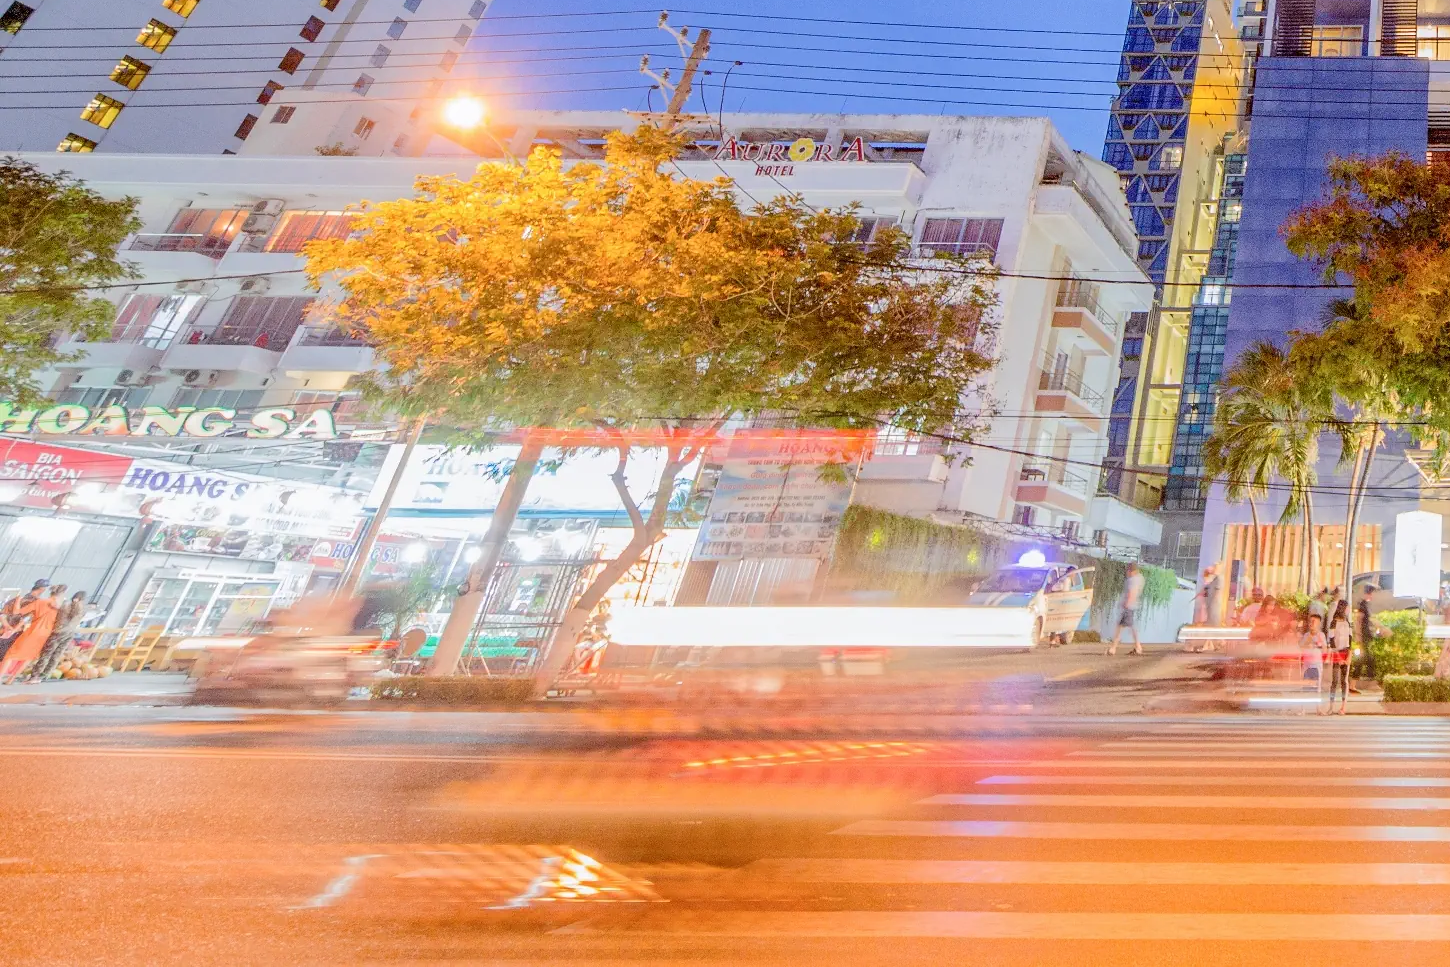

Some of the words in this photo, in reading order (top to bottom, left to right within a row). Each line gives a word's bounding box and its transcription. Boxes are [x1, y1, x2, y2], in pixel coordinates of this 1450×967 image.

[712, 135, 866, 162] AURORA
[755, 165, 795, 176] HOTEL
[0, 401, 237, 437] HOANG
[245, 409, 338, 438] SA
[37, 452, 63, 466] BIA
[125, 467, 228, 499] HOANG
